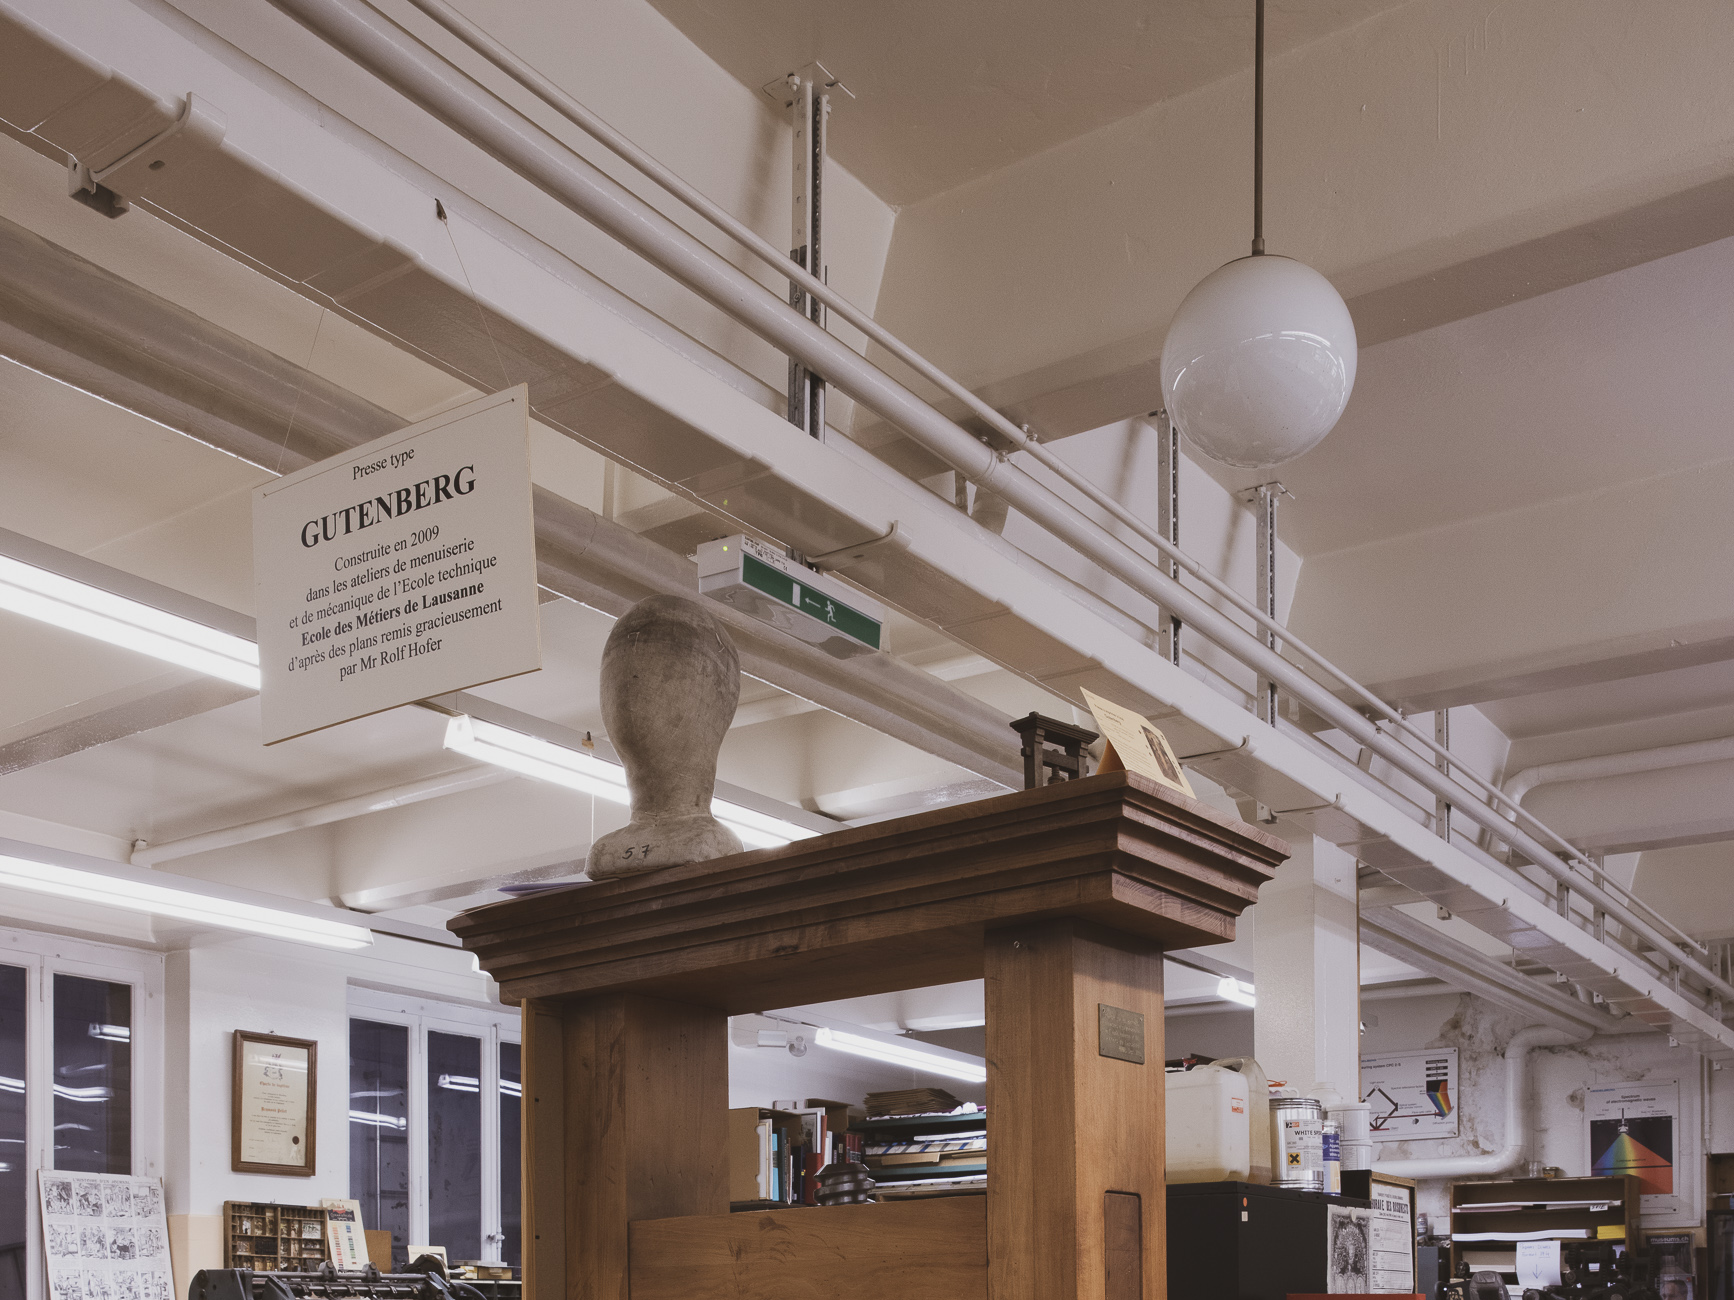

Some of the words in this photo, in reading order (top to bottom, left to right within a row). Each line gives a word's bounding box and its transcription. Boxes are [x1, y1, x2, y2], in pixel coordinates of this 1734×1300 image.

[352, 458, 388, 480] Presse
[390, 448, 415, 469] type
[301, 464, 477, 548] GUTENBERG
[305, 587, 330, 603] dans
[333, 580, 348, 594] les
[350, 566, 390, 588] ateliers
[393, 558, 407, 574] de
[410, 537, 475, 569] menuiserie
[334, 543, 391, 572] Construite
[394, 539, 407, 552] en
[410, 524, 440, 547] 2009
[289, 616, 299, 629] et
[301, 611, 314, 625] de
[316, 592, 374, 621] mécanique
[377, 585, 391, 600] de
[438, 555, 498, 582] technique
[301, 626, 332, 647] Ecole
[334, 621, 353, 636] des
[355, 606, 401, 630] Métiers
[404, 599, 419, 615] de
[422, 581, 485, 610] Lausanne
[328, 644, 347, 659] des
[349, 634, 378, 657] plans
[380, 623, 412, 642] remis
[415, 598, 503, 637] gracieusement
[339, 663, 358, 682] par
[360, 655, 378, 672] Mr
[380, 644, 407, 665] Rolf
[408, 637, 443, 658] Hofer
